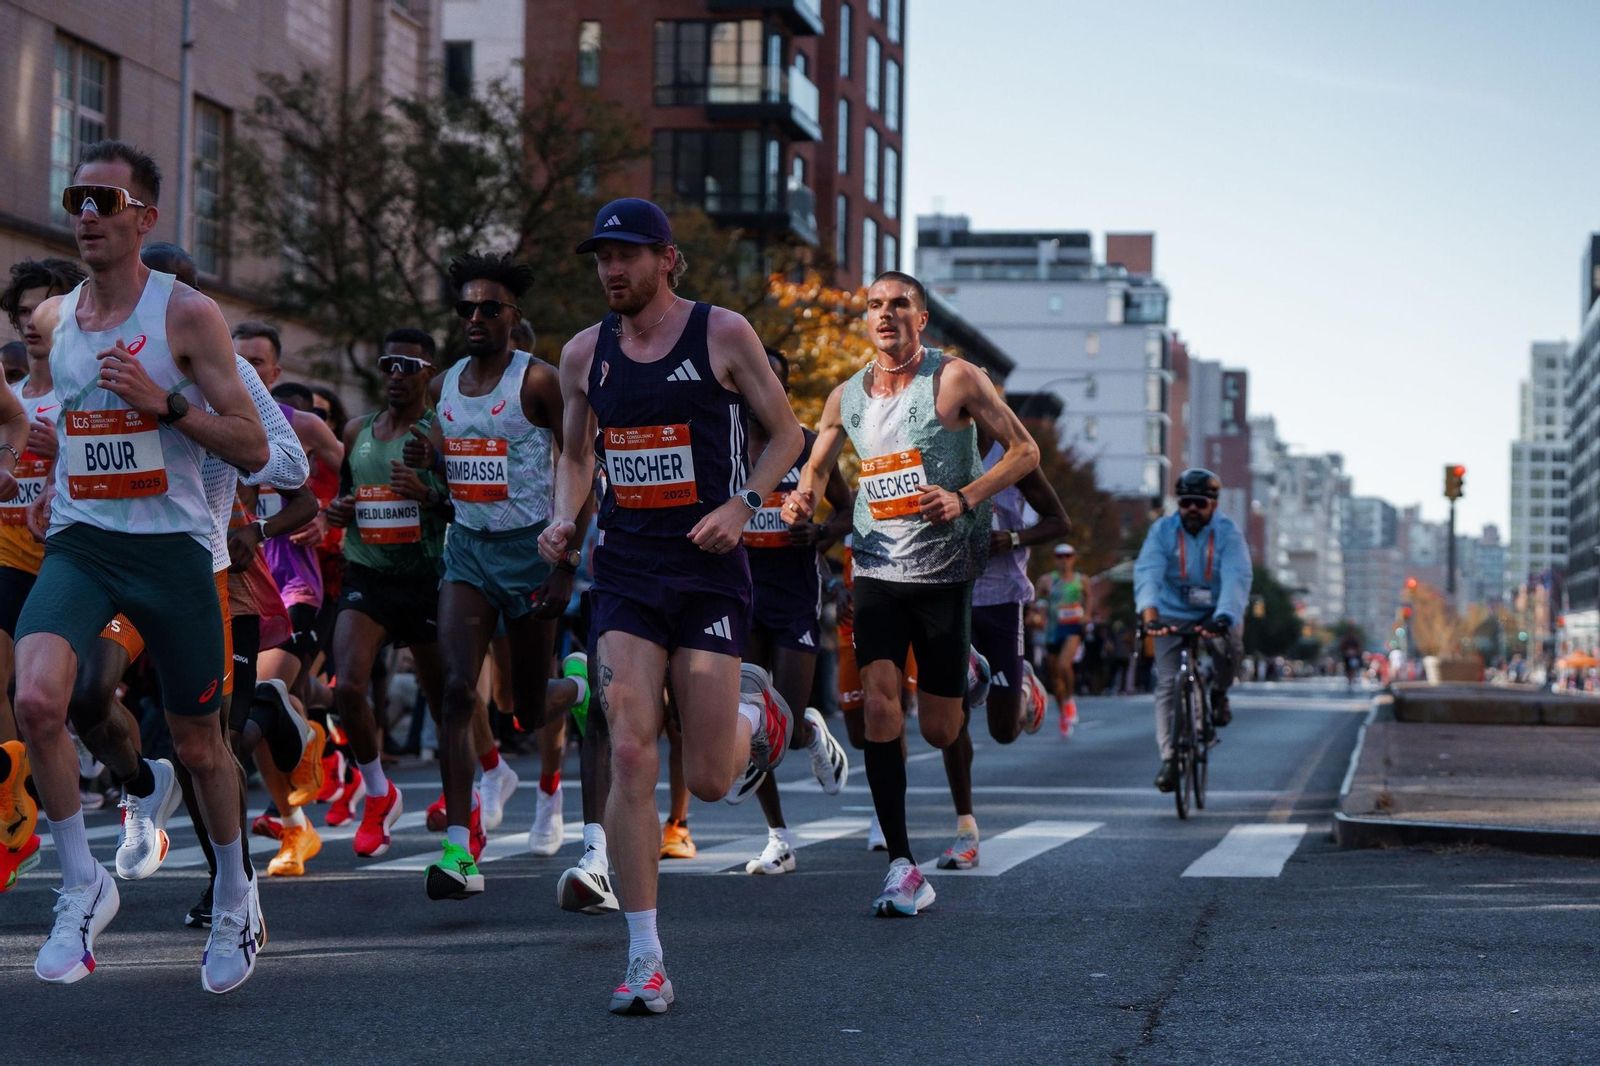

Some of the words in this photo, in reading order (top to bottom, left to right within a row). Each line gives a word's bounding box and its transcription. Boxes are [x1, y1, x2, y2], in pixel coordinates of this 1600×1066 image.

[72, 415, 89, 429] tcs
[610, 431, 626, 444] tcs
[449, 441, 461, 451] tcs
[84, 441, 138, 471] BOUR
[446, 460, 505, 481] SIMBASSA
[612, 453, 685, 483] FISCHER
[861, 462, 876, 472] tcs
[130, 478, 161, 490] 2025
[864, 472, 920, 500] KLECKER
[360, 487, 372, 498] tcs
[663, 488, 691, 500] 2025
[356, 506, 418, 520] WELDLIBANOS
